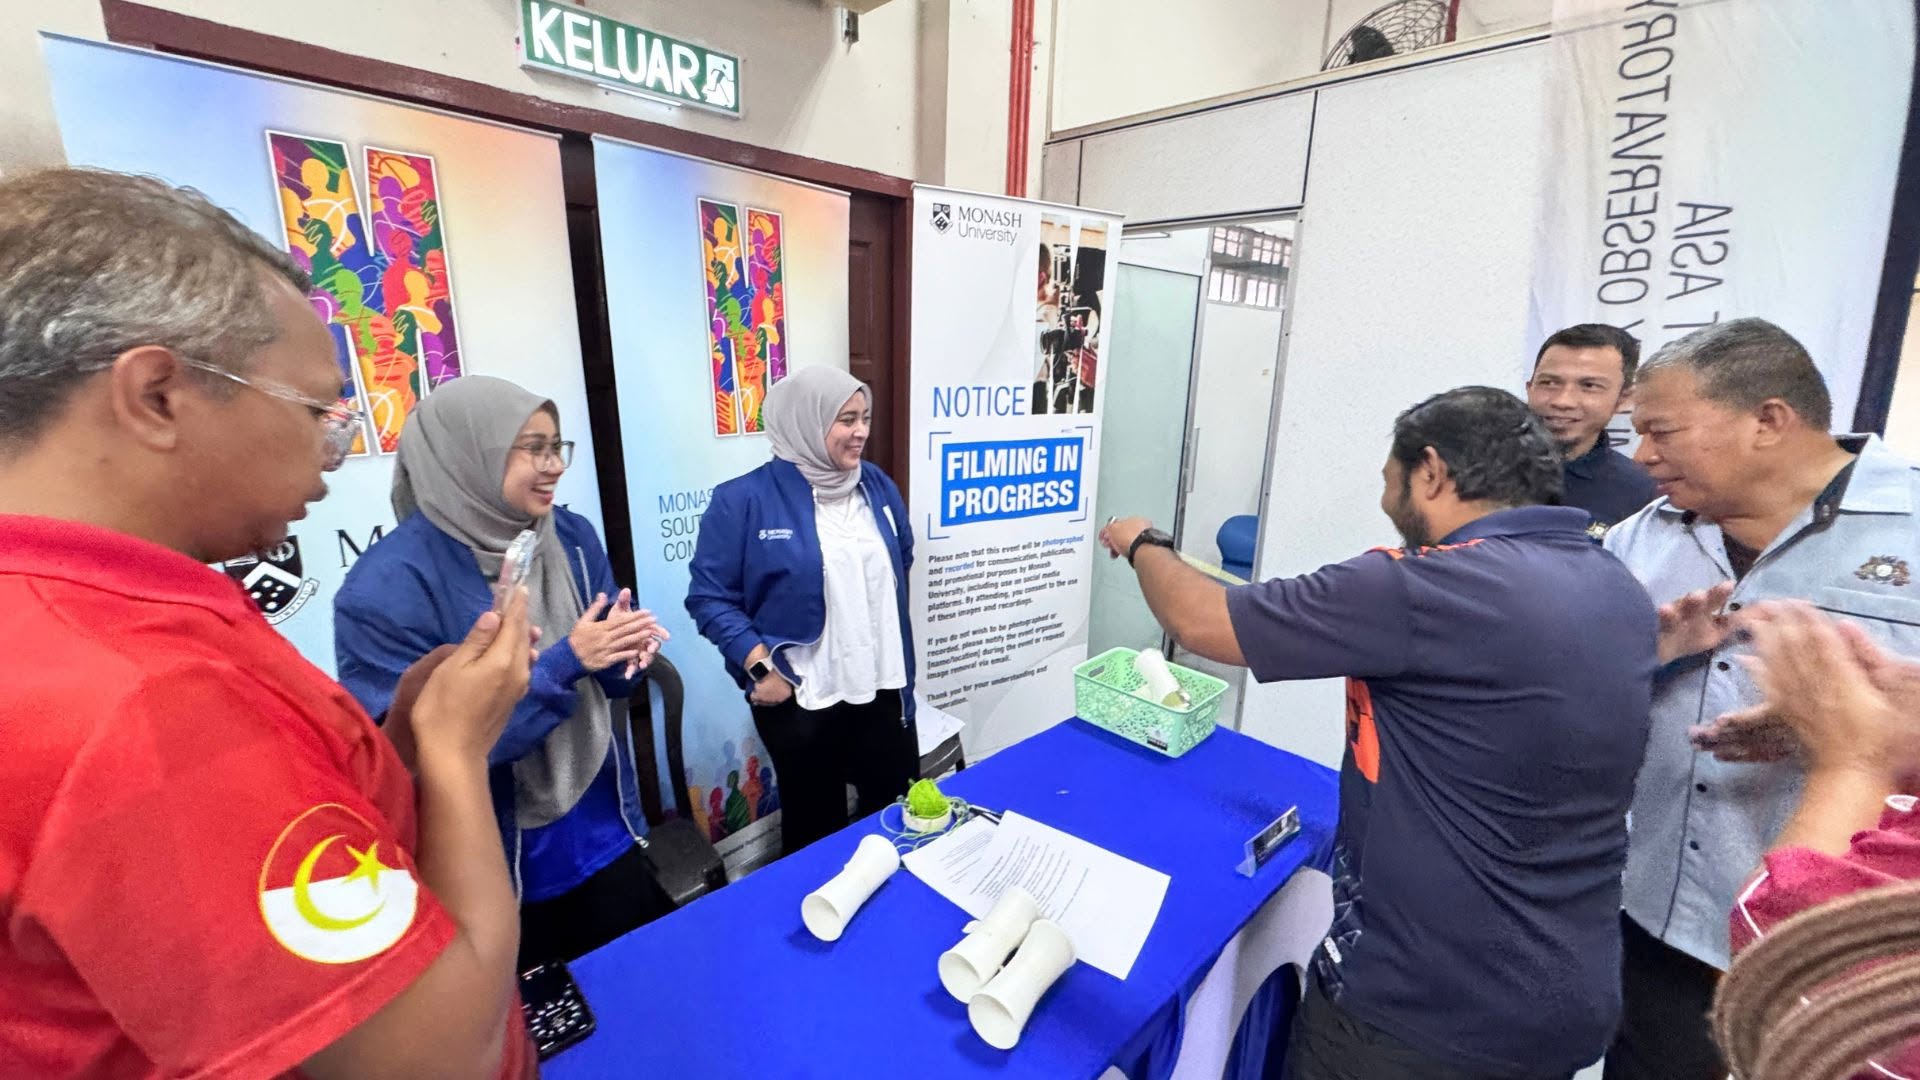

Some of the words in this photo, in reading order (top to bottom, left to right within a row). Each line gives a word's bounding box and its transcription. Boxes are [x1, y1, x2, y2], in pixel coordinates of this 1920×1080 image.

[530, 2, 700, 99] KELUAR
[958, 206, 1022, 228] MONASH
[958, 224, 1018, 246] University
[933, 386, 1026, 417] NOTICE
[947, 445, 1048, 481] FILMING
[1053, 445, 1079, 472] IN
[948, 479, 1075, 518] PROGRESS
[928, 554, 953, 563] Please
[971, 548, 984, 557] that
[1002, 544, 1020, 553] event
[1022, 542, 1032, 550] will
[1042, 535, 1084, 547] photographed
[928, 567, 943, 575] and
[945, 561, 975, 573] recorded
[928, 579, 943, 587] and
[945, 571, 984, 586] promotional
[986, 568, 1018, 578] purposes
[1028, 561, 1051, 571] Monash
[966, 596, 973, 604] By
[1025, 583, 1047, 593] consent
[967, 582, 999, 592] including
[1024, 573, 1041, 583] social
[928, 614, 936, 622] of
[937, 613, 956, 621] these
[958, 607, 981, 616] images
[935, 637, 948, 646] you
[960, 630, 970, 638] not
[972, 627, 988, 635] wish
[1008, 613, 1049, 630] photographed
[962, 639, 983, 650] please
[985, 635, 1005, 643] notify
[1018, 628, 1034, 638] event
[982, 646, 1004, 656] during
[1018, 638, 1033, 648] event
[1042, 631, 1065, 642] request
[927, 670, 949, 679] image
[951, 661, 977, 674] removal
[927, 691, 947, 701] Thank
[950, 688, 961, 698] you
[974, 681, 989, 691] your
[991, 669, 1035, 685] understanding
[1036, 665, 1048, 673] and
